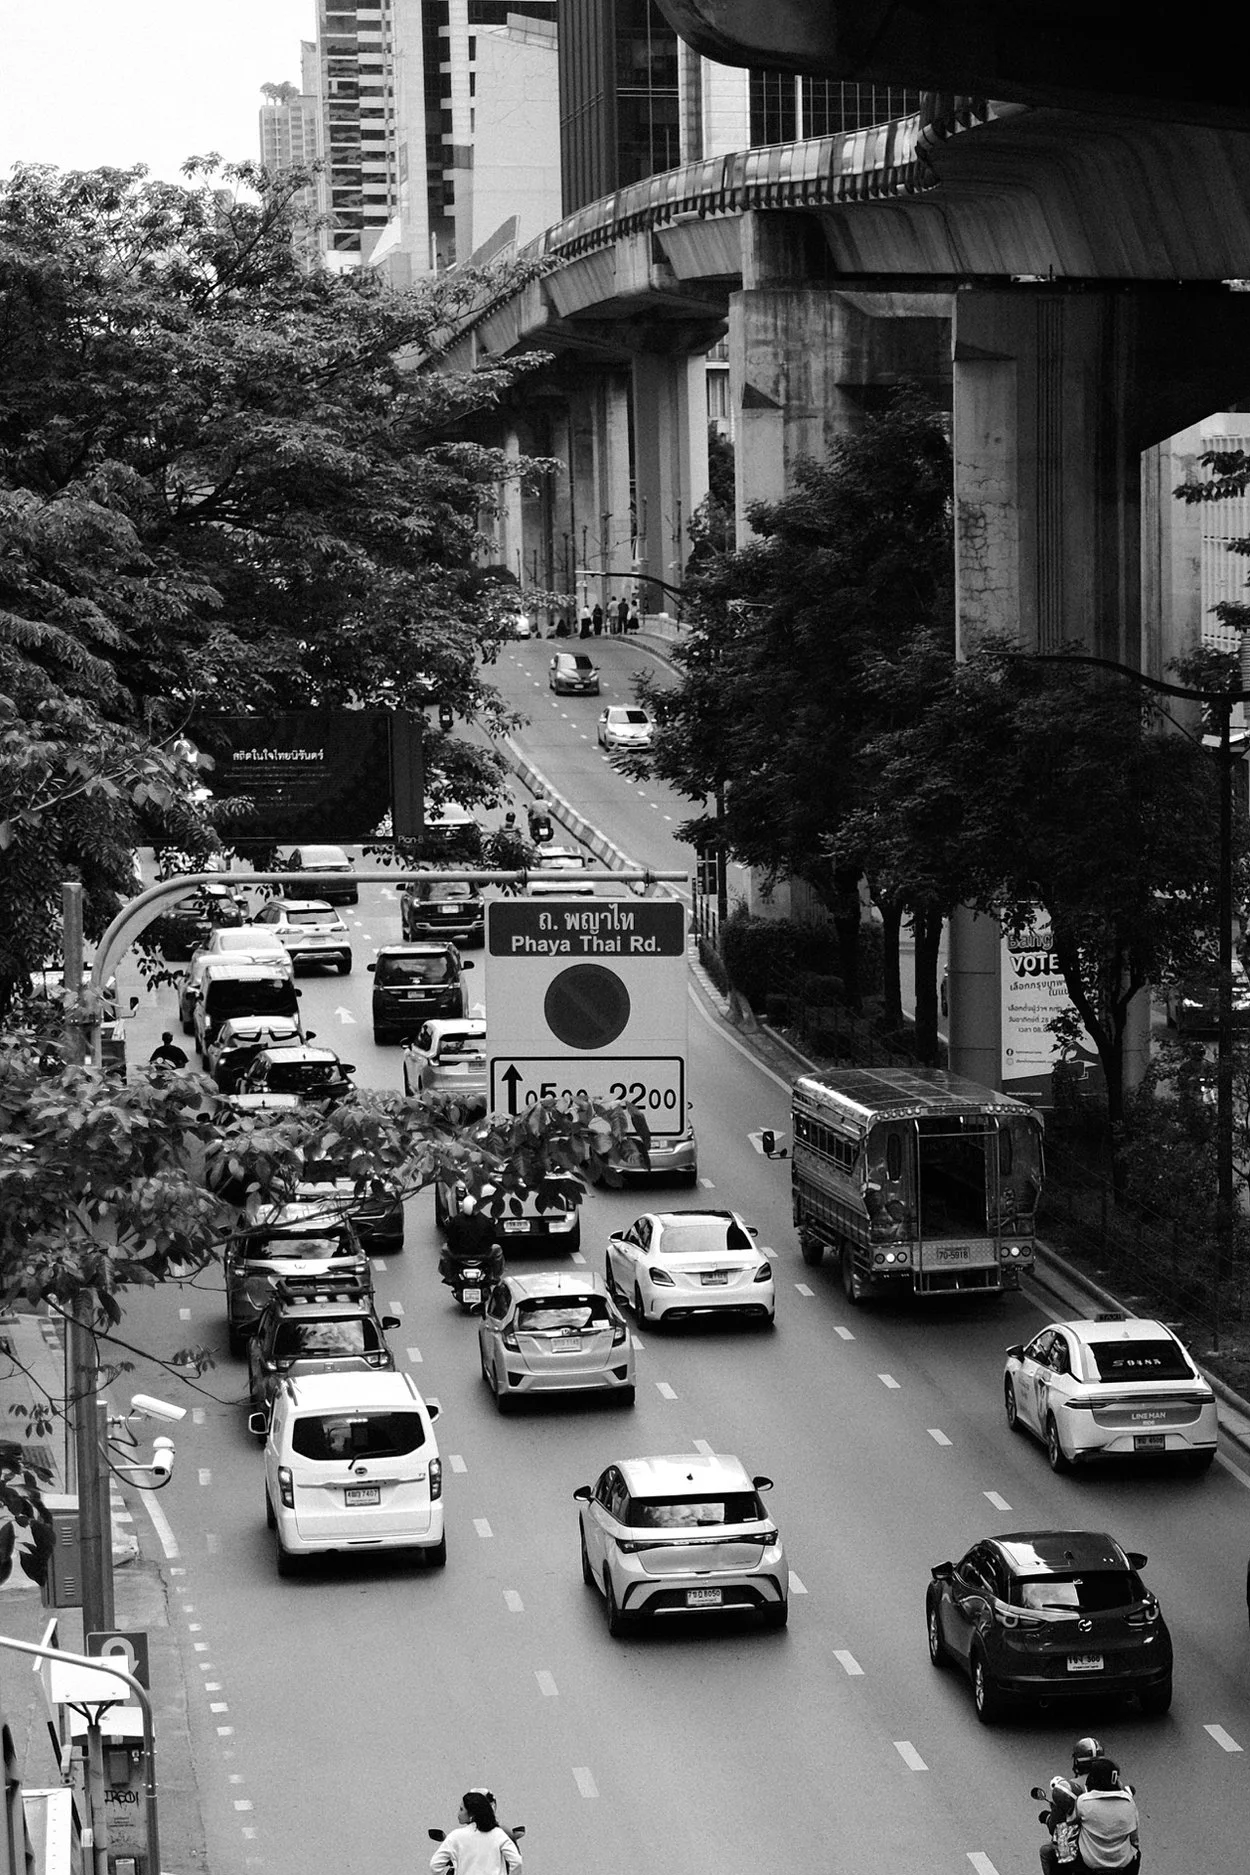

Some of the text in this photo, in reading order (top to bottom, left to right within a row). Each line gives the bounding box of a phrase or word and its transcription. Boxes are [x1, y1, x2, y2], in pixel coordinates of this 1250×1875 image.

[539, 903, 635, 935] ถ. พญาไท
[511, 935, 662, 956] Phaya Thai Rd.
[1010, 953, 1059, 972] VOTE
[1149, 1412, 1166, 1420] MAN
